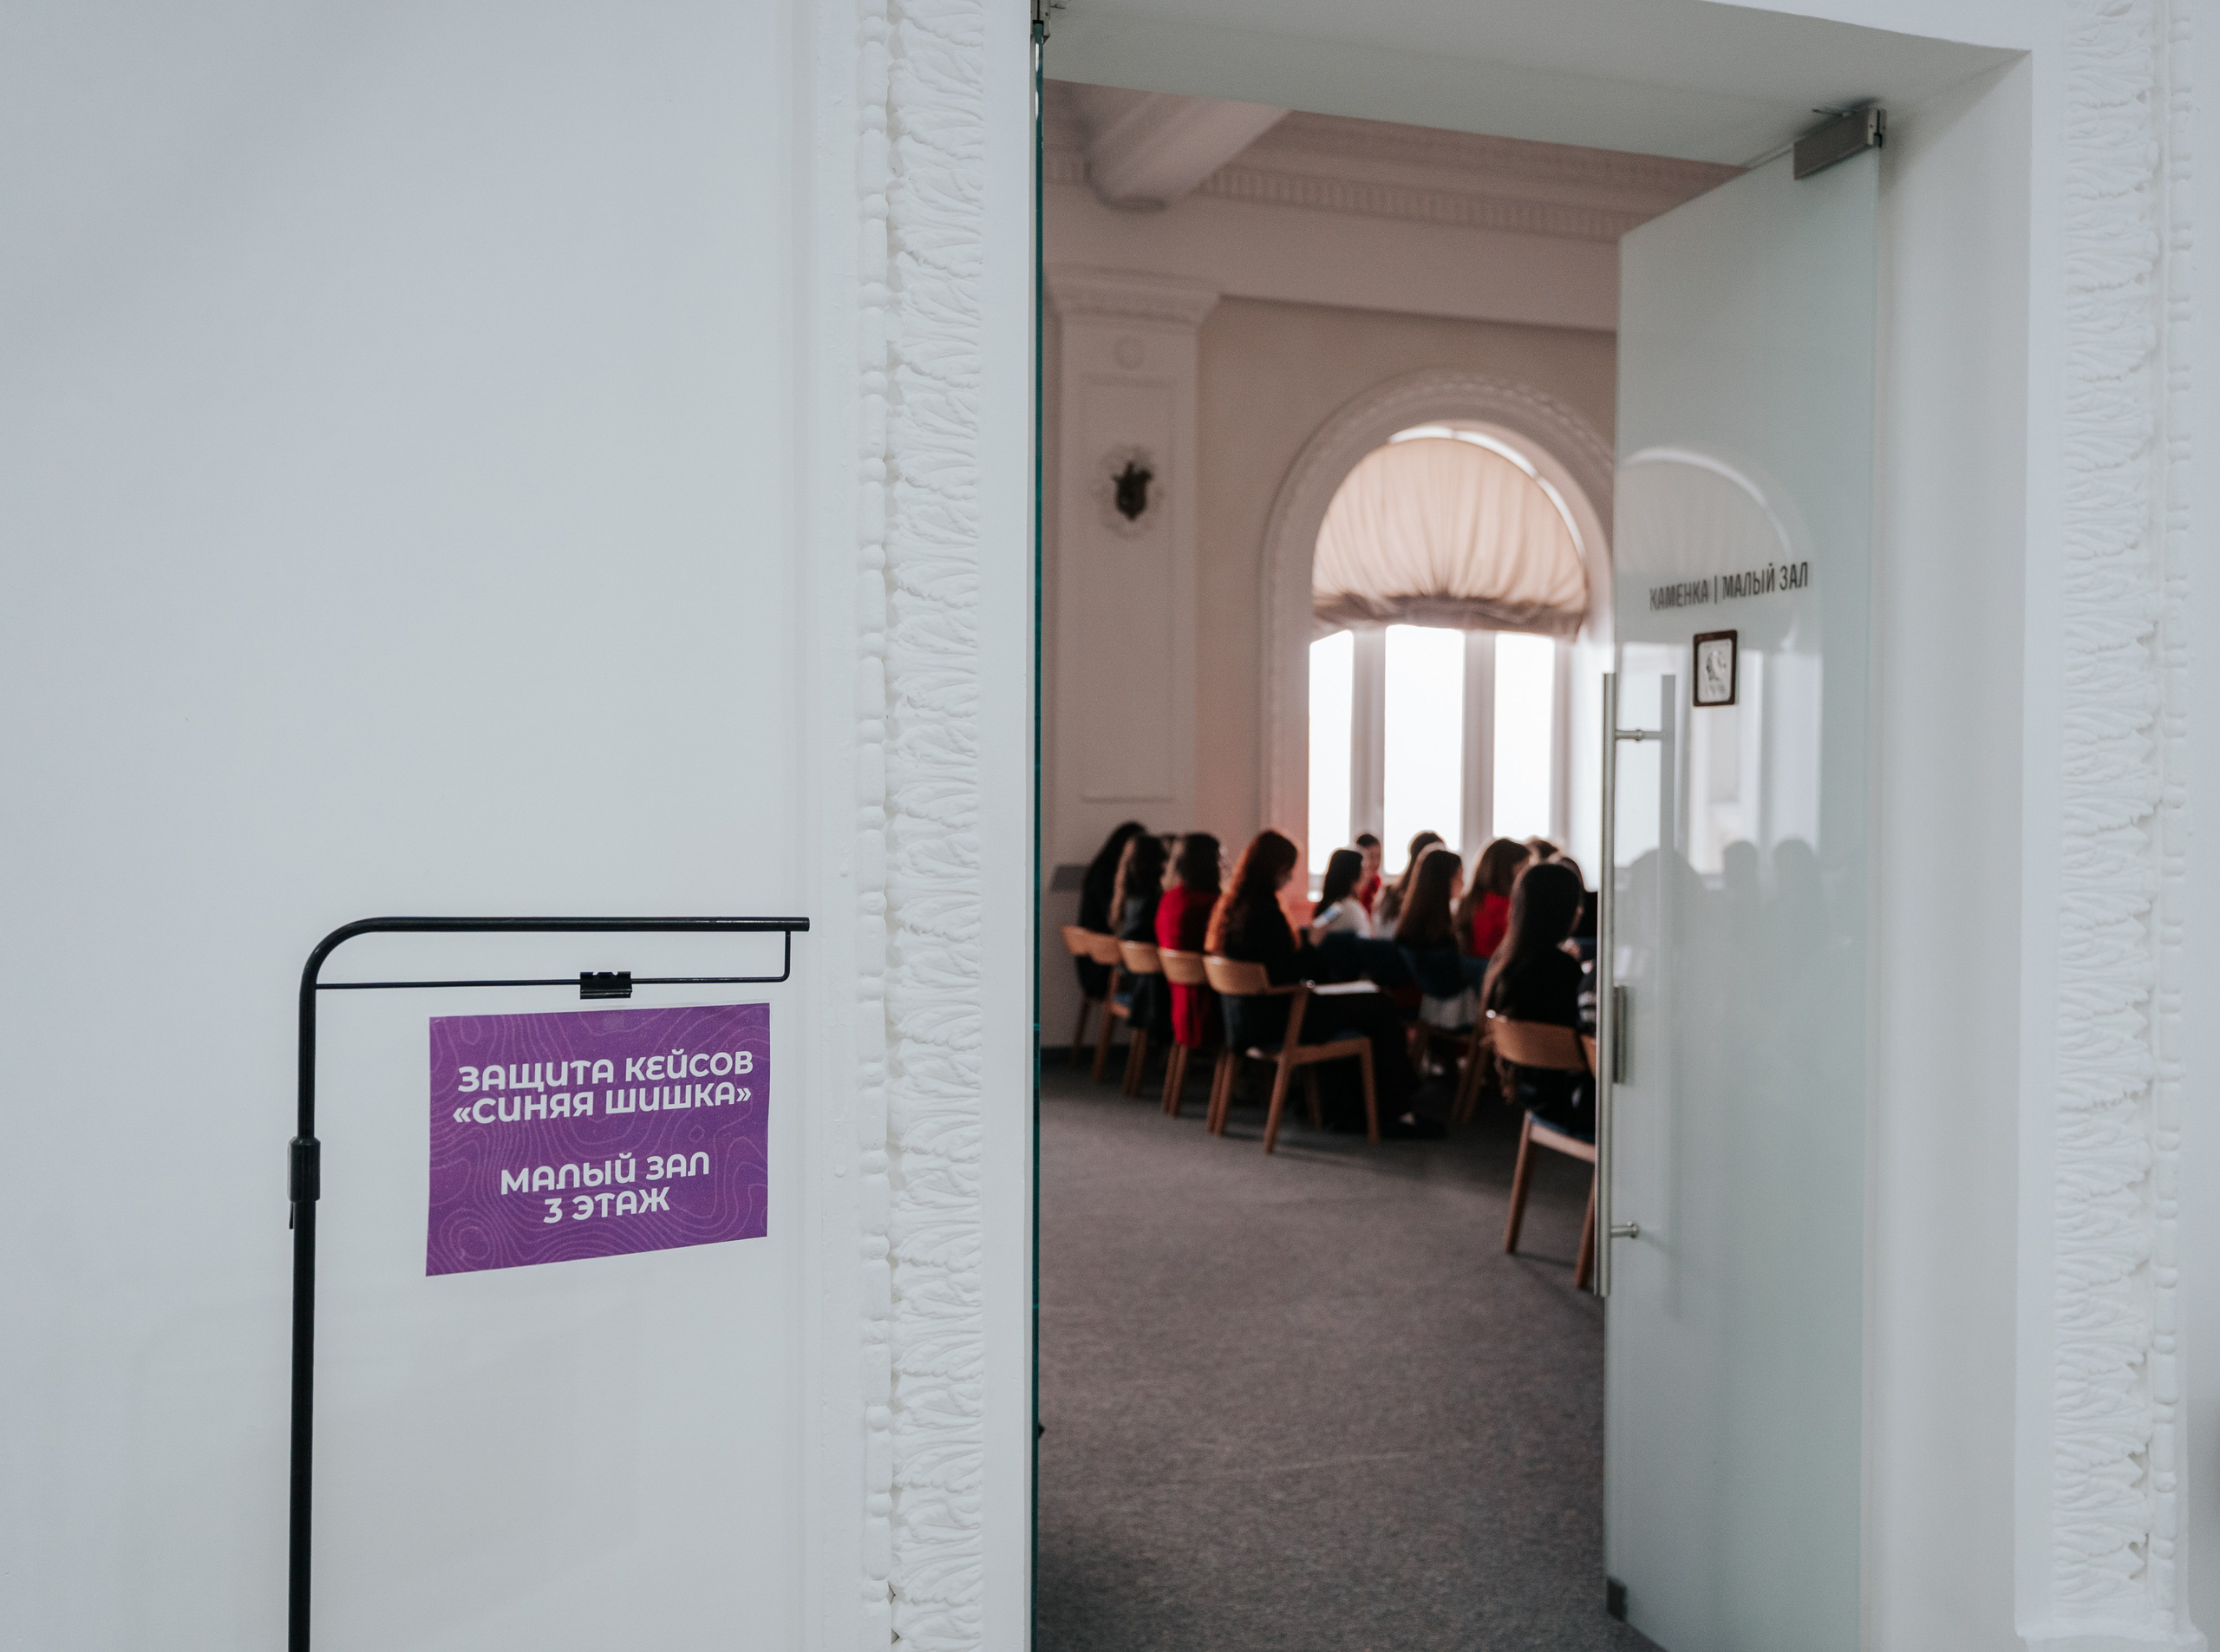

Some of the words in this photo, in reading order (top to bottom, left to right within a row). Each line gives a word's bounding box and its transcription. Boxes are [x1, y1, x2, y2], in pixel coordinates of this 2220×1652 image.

[1649, 578, 1709, 611] КАМЕНКА
[1721, 562, 1775, 600] МАЛЫЙ
[1779, 561, 1809, 591] ЗАЛ
[457, 1059, 614, 1093] ЗАЩИТА
[625, 1048, 754, 1082] КЕЙСОВ
[453, 1091, 594, 1124] «СИНЯЯ
[605, 1081, 752, 1114] ШИШКА»
[500, 1152, 636, 1195] МАЛЫЙ
[645, 1151, 709, 1180] ЗАЛ
[543, 1198, 563, 1224] 3
[571, 1186, 670, 1221] ЭТАЖ
